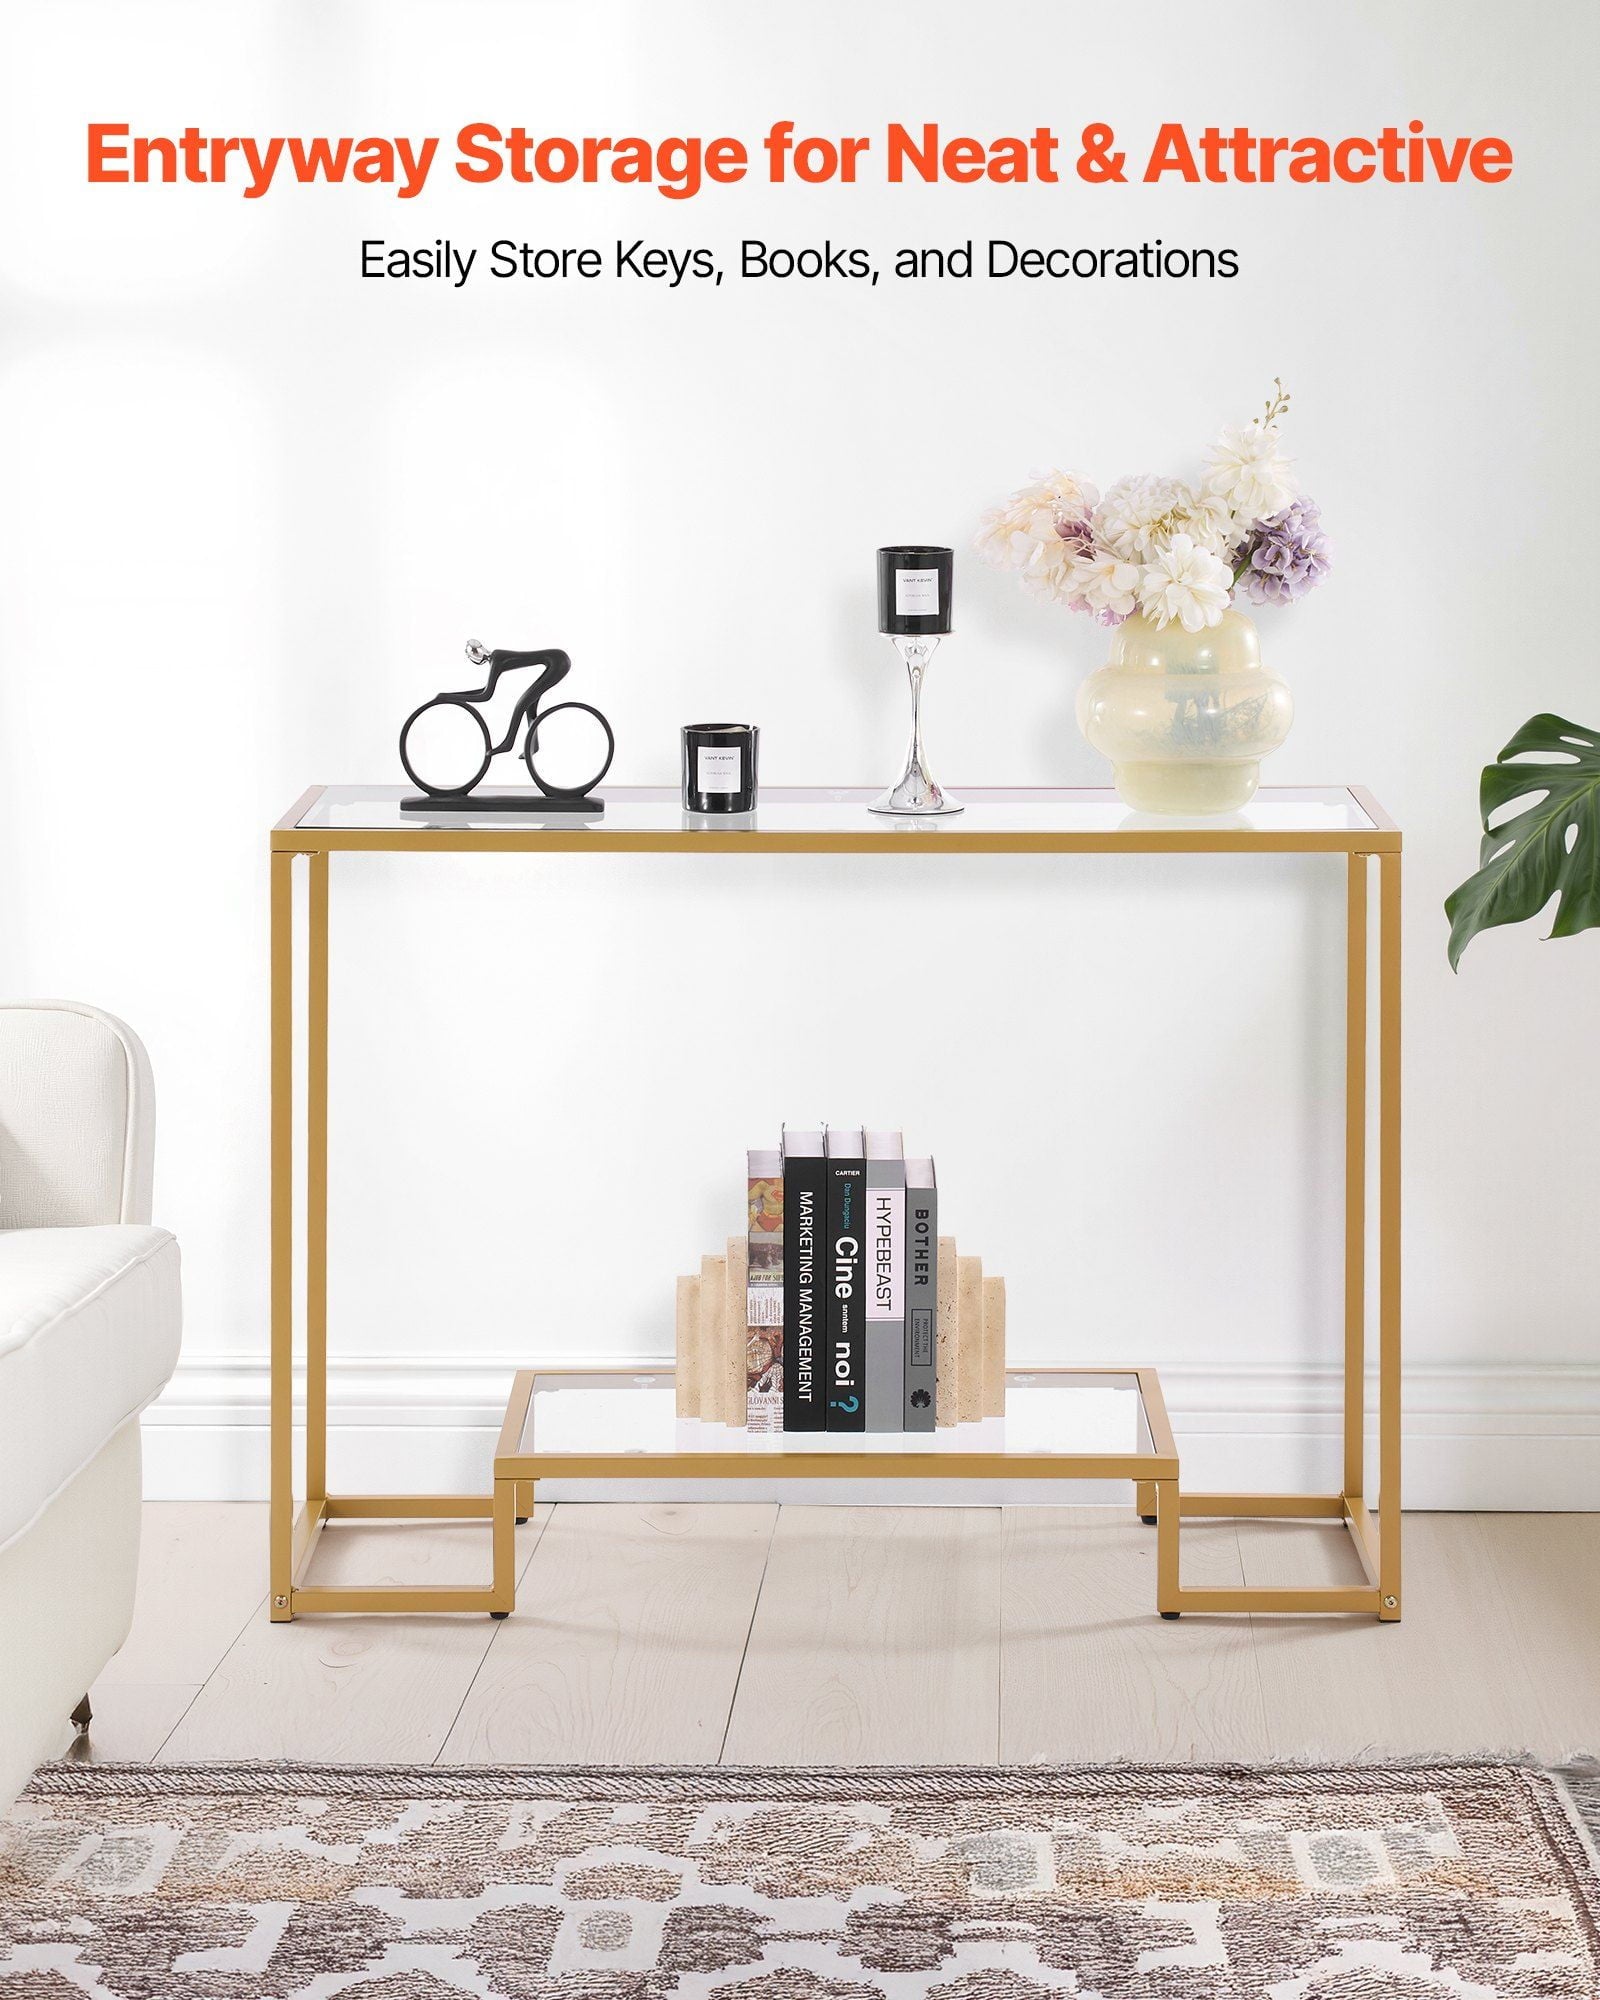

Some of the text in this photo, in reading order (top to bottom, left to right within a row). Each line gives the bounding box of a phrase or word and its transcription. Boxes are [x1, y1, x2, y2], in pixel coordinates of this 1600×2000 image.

[835, 1236, 859, 1299] Cine
[876, 1197, 892, 1311] HYPEBEAST
[914, 1209, 930, 1286] BOTHER
[798, 1191, 814, 1402] MARKETING MANAGEMENT
[835, 1342, 855, 1386] noi
